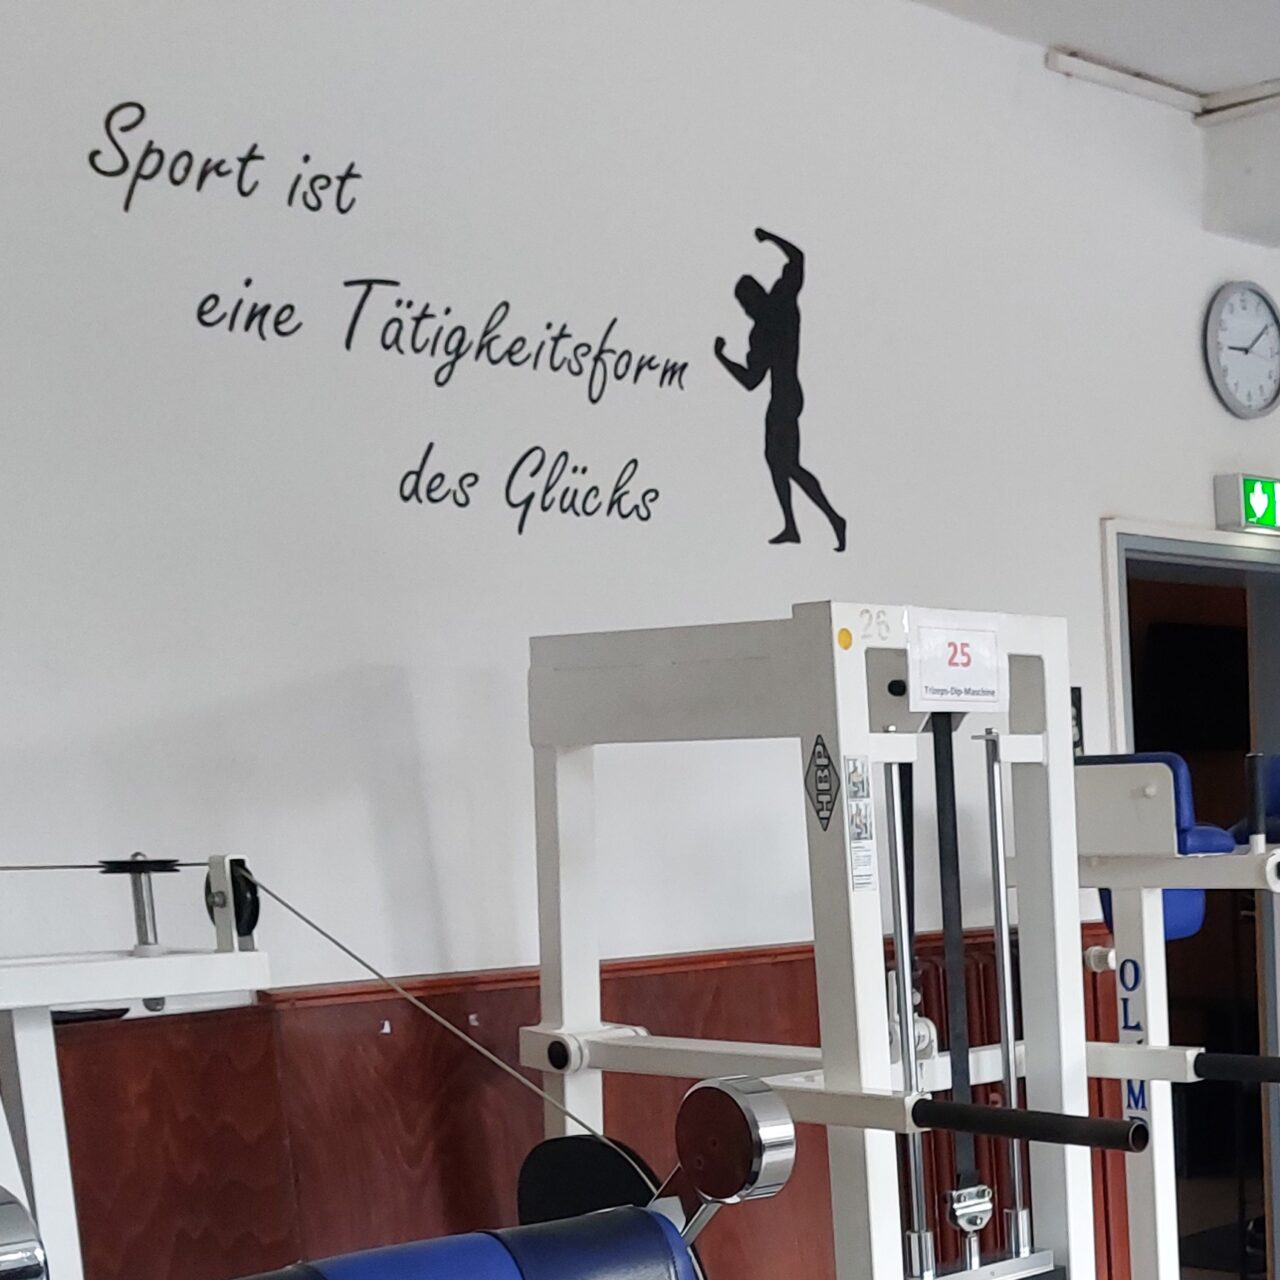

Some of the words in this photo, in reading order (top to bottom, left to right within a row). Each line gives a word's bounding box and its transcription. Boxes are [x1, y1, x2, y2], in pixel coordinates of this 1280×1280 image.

[88, 101, 265, 213] Sport
[287, 153, 363, 215] ist
[196, 277, 303, 341] eine
[343, 278, 689, 405] Tätigkeitsform
[399, 441, 480, 508] des
[504, 445, 660, 536] Glücks
[947, 641, 972, 668] 25
[814, 744, 832, 819] HBP
